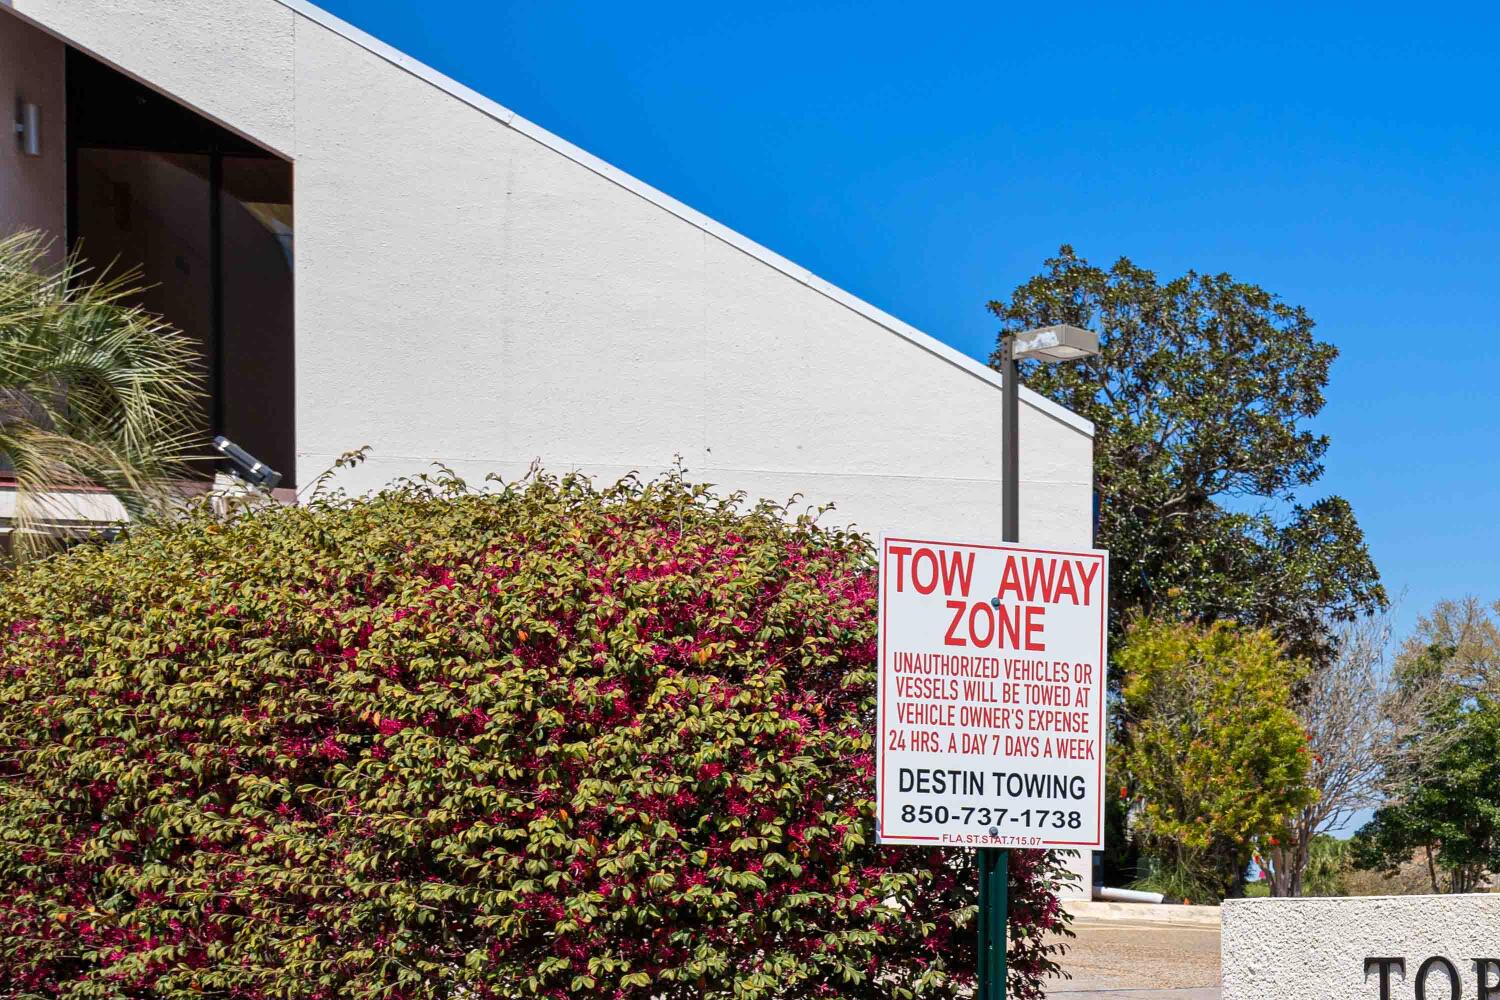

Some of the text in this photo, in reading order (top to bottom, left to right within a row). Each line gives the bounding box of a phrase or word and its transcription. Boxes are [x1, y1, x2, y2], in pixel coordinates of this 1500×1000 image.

[889, 546, 1100, 606] TOW AWAY
[944, 600, 1046, 651] ZONE
[893, 651, 1093, 685] UNAUTHORIZED VEHICLES OR
[895, 676, 1091, 708] VESSELS WILL BE TOWED AT
[896, 702, 1089, 734] VEHICLE OWNER'S EXPENSE
[889, 729, 1095, 760] 24 HRS. A DAY 7 DAYS A WEEK
[899, 767, 1086, 800] DESTIN TOWING
[901, 804, 1082, 830] 850-737-1738
